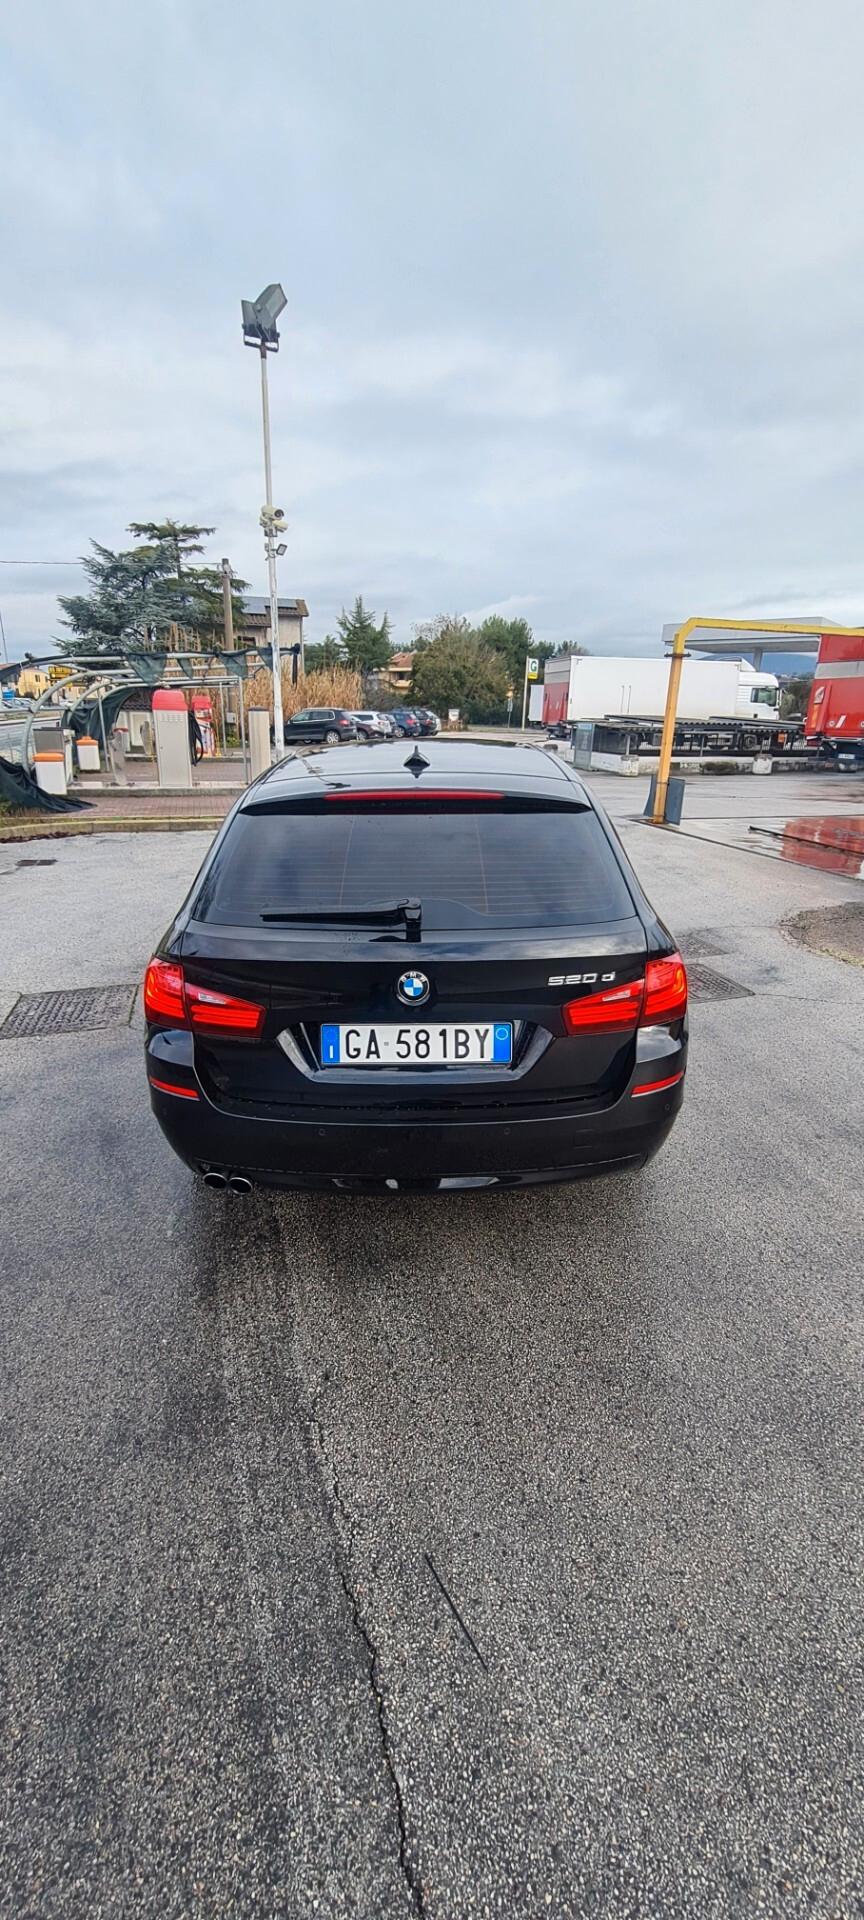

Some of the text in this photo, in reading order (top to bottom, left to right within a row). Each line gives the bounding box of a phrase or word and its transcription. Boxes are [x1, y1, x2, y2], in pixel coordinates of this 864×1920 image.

[400, 971, 427, 982] BMW
[547, 973, 598, 986] 520
[345, 1028, 490, 1059] GA 581BY
